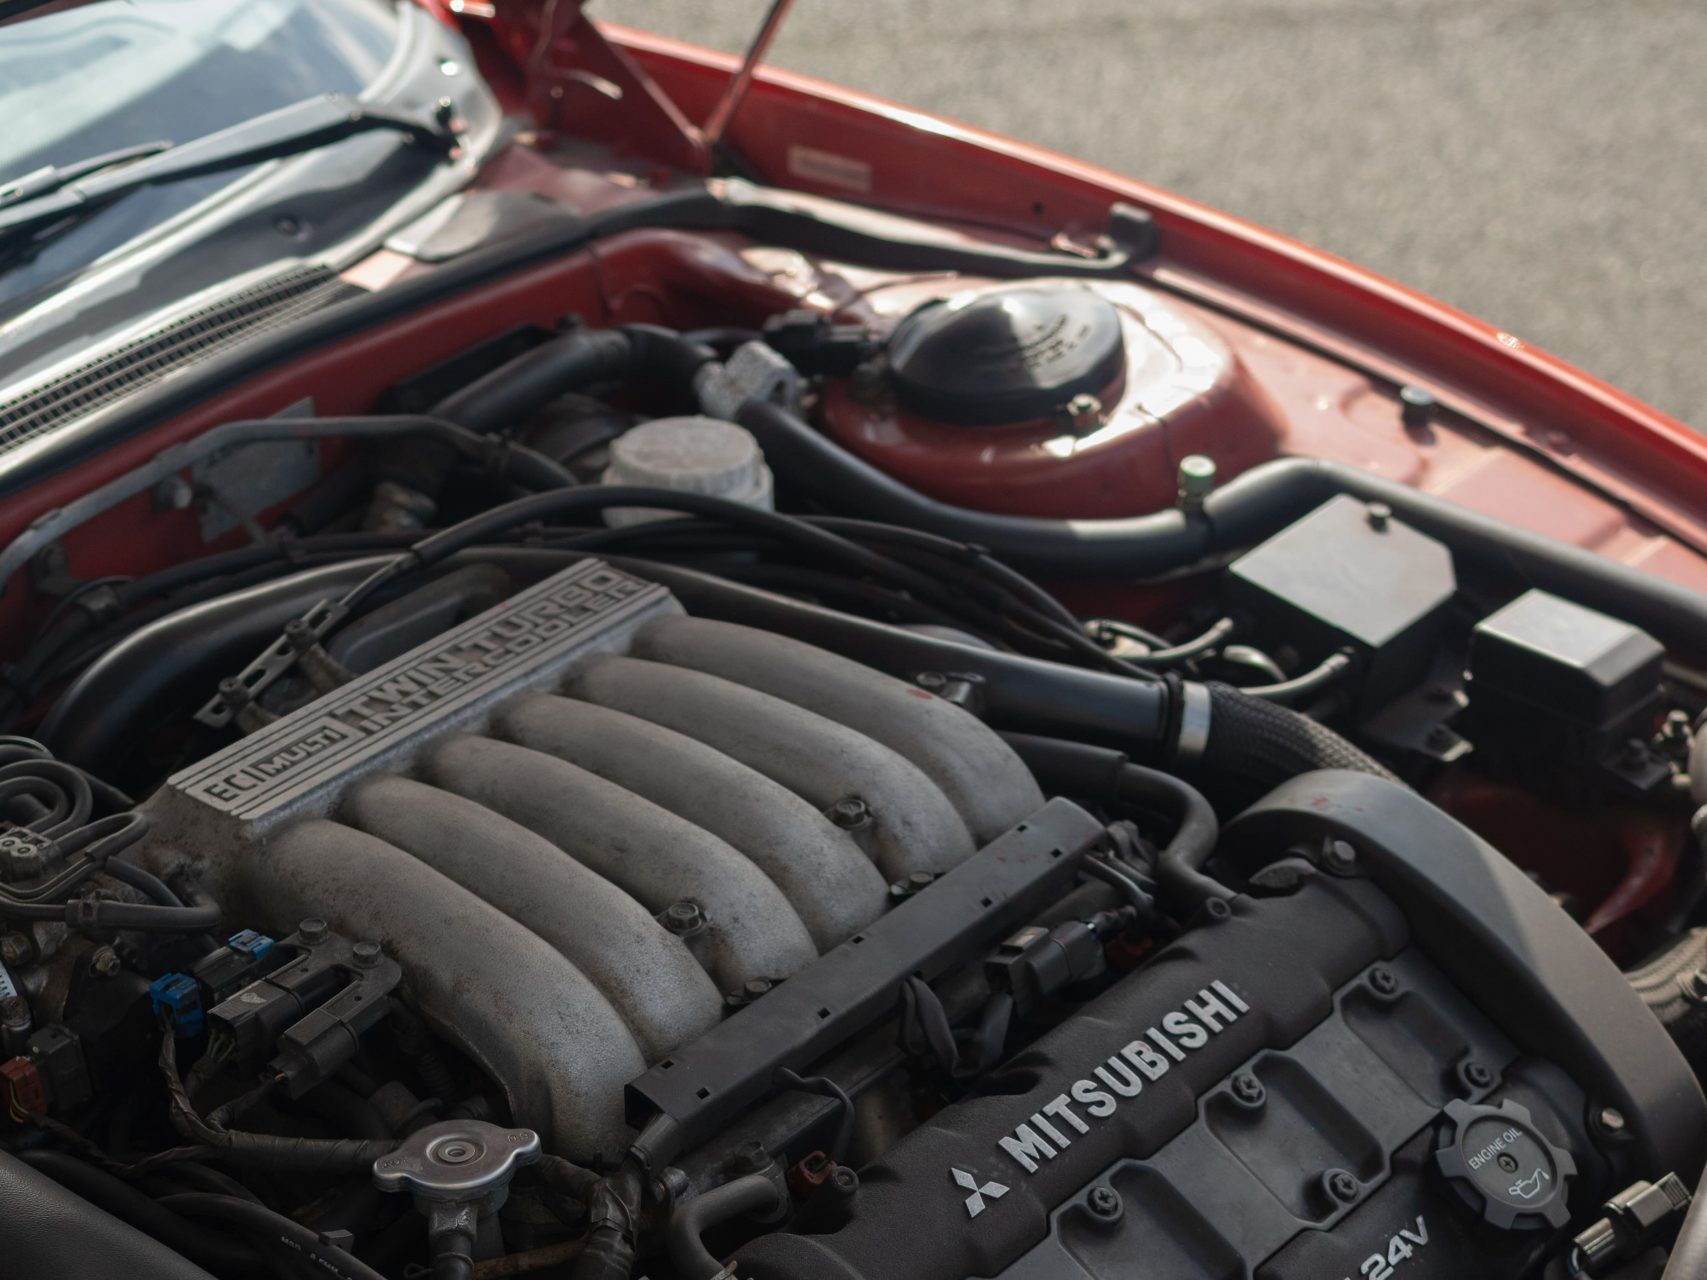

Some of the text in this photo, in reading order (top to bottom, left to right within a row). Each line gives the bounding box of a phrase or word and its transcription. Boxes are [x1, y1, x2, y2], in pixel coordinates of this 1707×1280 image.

[332, 570, 624, 718] TWIN TURBO
[358, 579, 645, 731] INTERCOOLER
[203, 725, 348, 802] ECI MULTI
[997, 979, 1250, 1174] MITSUBISHI
[1468, 1127, 1523, 1170] ENGINE OIL
